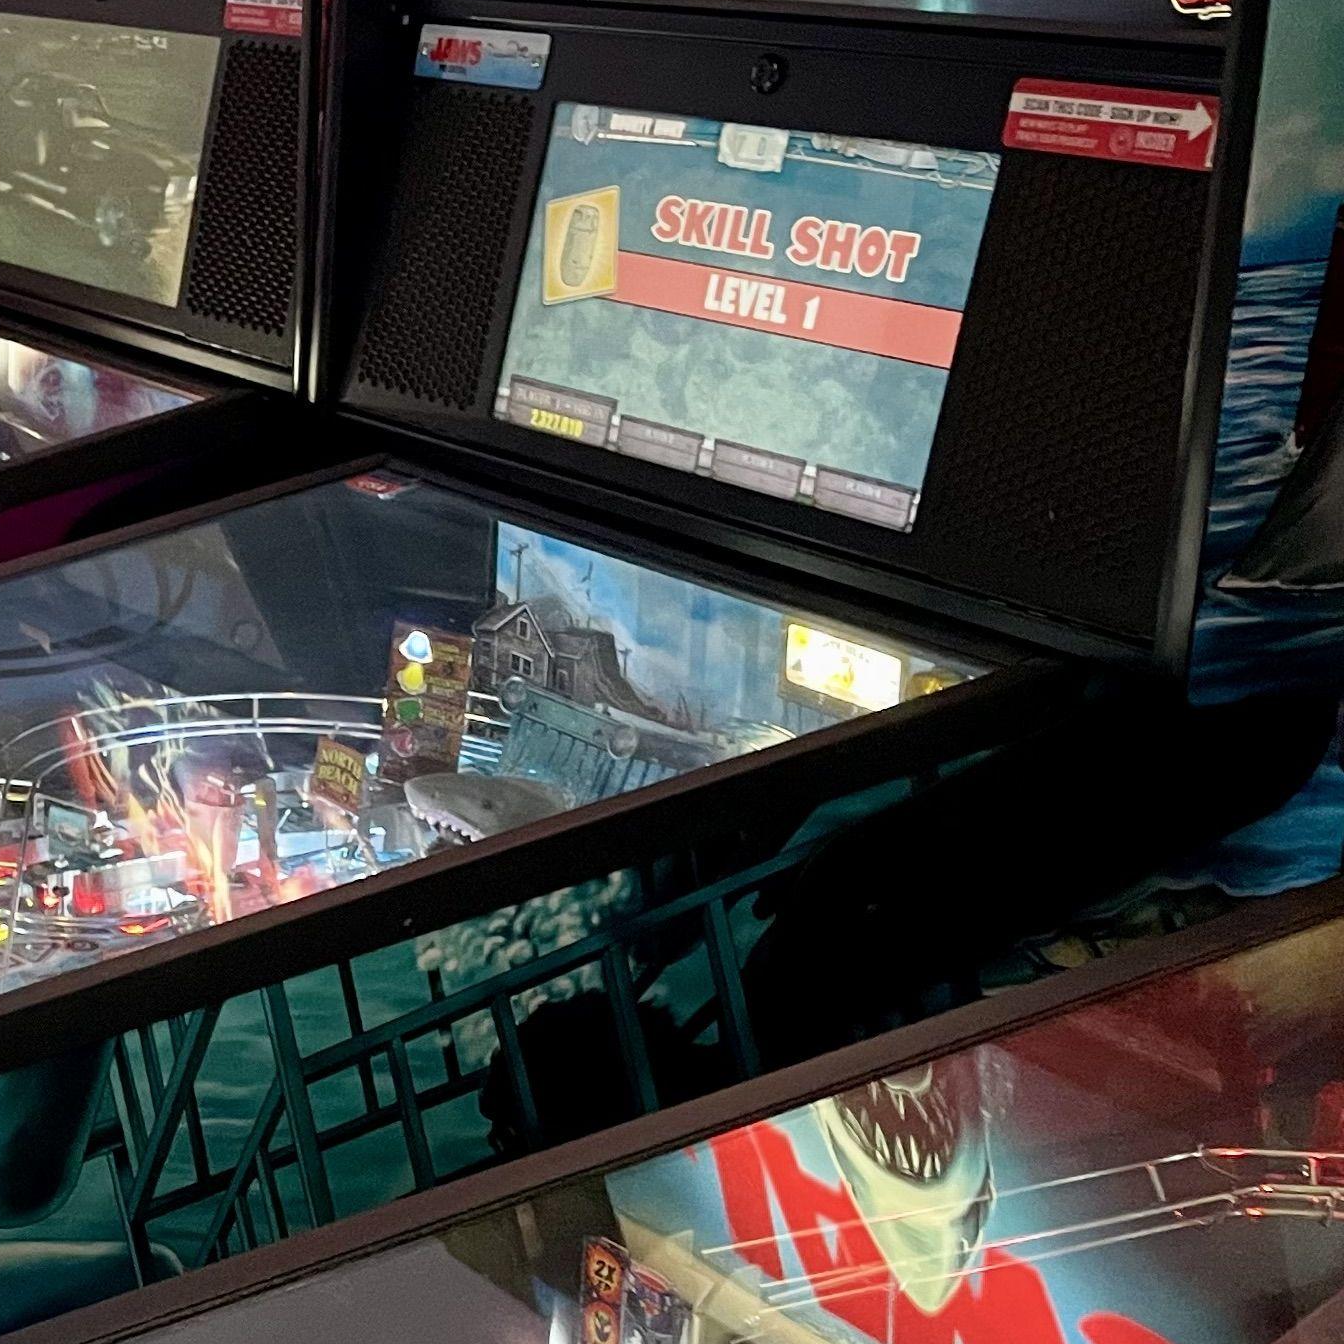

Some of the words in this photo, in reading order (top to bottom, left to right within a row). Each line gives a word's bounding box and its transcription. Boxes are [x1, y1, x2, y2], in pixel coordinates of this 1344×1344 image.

[429, 37, 483, 67] JAWS
[651, 195, 775, 260] SKILL
[786, 216, 921, 283] SHOT
[704, 274, 788, 326] LEVEL
[803, 295, 822, 331] 1
[317, 766, 360, 798] BEACH
[320, 749, 362, 782] NORTH
